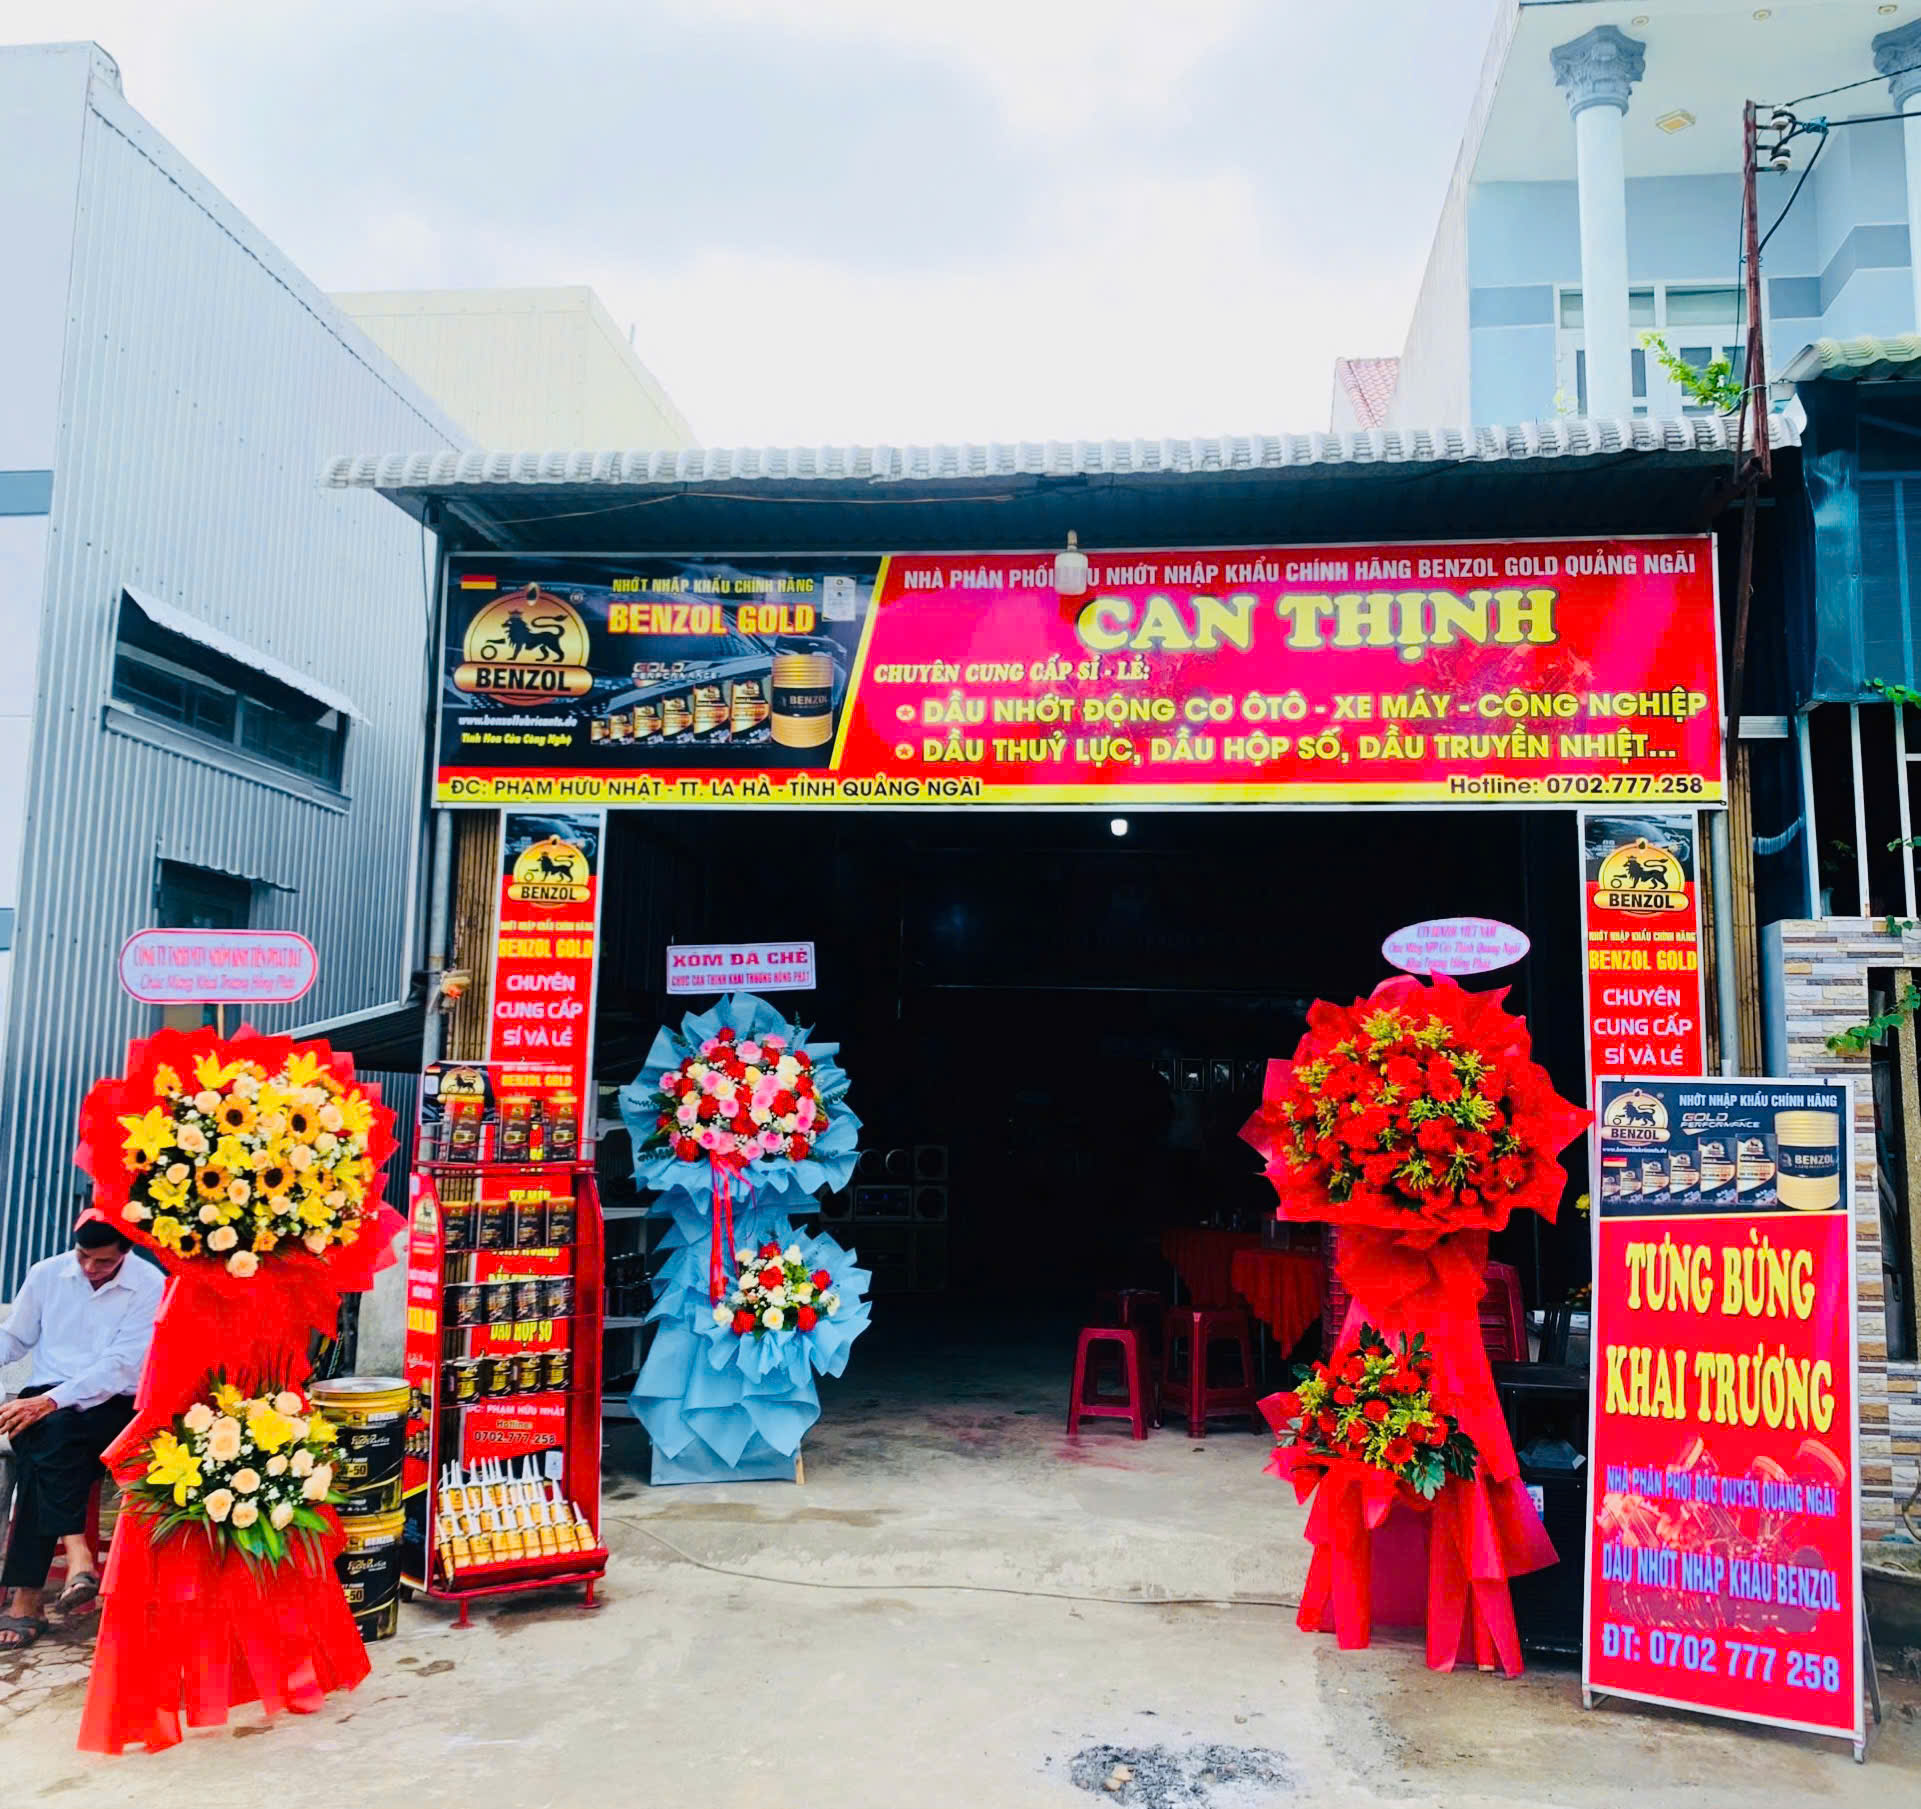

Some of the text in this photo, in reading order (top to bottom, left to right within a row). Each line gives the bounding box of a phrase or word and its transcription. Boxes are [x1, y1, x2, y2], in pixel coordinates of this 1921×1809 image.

[905, 566, 944, 589] NHÀ
[950, 565, 1003, 589] PHÂN
[1009, 561, 1054, 588] PHỐI
[1106, 562, 1157, 586] NHỚT
[1164, 561, 1218, 588] NHẬP
[1225, 555, 1279, 583] KHẨU
[1286, 556, 1348, 581] CHÍNH
[1355, 555, 1412, 579] HÃNG
[1418, 558, 1499, 579] BENZOL
[1505, 557, 1559, 577] GOLD
[1565, 549, 1637, 577] QUẢNG
[1644, 550, 1696, 575] NGÃI
[612, 576, 648, 593] NHỚT
[652, 576, 689, 596] NHẬP
[693, 574, 730, 593] KHẨU
[607, 602, 815, 635] BENZOL GOLD
[1076, 587, 1559, 661] CAN THỊNH
[475, 667, 571, 692] BENZOL
[874, 660, 959, 683] CHUYÊN
[966, 663, 1025, 682] CUNG
[1030, 653, 1073, 681] CẤP
[924, 690, 985, 723] DẦU
[993, 691, 1075, 723] NHỚT
[1083, 692, 1175, 728] ĐỘNG
[1183, 696, 1233, 722] CƠ
[1242, 690, 1308, 721] ÔTÔ
[1334, 694, 1372, 719] XE
[1381, 689, 1450, 719] MÁY
[1478, 687, 1580, 717] CÔNG
[1588, 685, 1708, 723] NGHIỆP
[923, 722, 1678, 768] DẦU THUỶ LỰC, DẦU HỘP SỐ, DẦU TRUYỀN NHIỆT...
[451, 779, 487, 796] ĐC:
[495, 779, 553, 801] PHẠM
[561, 774, 601, 797] HỮU
[609, 774, 661, 801] NHẬT
[680, 780, 704, 797] TT.
[712, 780, 735, 797] LA
[741, 774, 771, 797] HÀ
[790, 773, 835, 797] TỈNH
[843, 772, 920, 797] QUẢNG
[927, 776, 981, 797] NGÃI
[1450, 776, 1704, 796] Hotline: 0702.777.258
[520, 886, 577, 901] BENZOL
[1609, 893, 1675, 909] BENZOL
[498, 937, 594, 958] BENZOL GOLD
[1588, 949, 1698, 971] BENZOL GOLD
[506, 972, 576, 991] CHUYÊN
[496, 995, 584, 1020] CUNG CẤP
[1603, 985, 1681, 1007] CHUYÊN
[1594, 1011, 1693, 1037] CUNG CẤP
[525, 1027, 549, 1047] VÀ
[1629, 1044, 1657, 1065] VÀ
[1679, 1090, 1838, 1108] NHỚT NHẬP KHẨU CHÍNH HÃNG
[1680, 1112, 1760, 1129] GOLD PERFORMANCE
[1611, 1127, 1659, 1141] BENZOL
[1795, 1154, 1833, 1165] BENZOL
[1626, 1227, 1815, 1320] TƯNG BỪNG
[1605, 1342, 1835, 1433] KHAI TRƯƠNG
[1602, 1531, 1633, 1582] DẦU
[1637, 1542, 1678, 1588] NHỚT
[1729, 1547, 1773, 1603] KHẨU
[1777, 1563, 1841, 1612] BENZOL
[1602, 1623, 1840, 1693] ĐT: 0702 777 258
